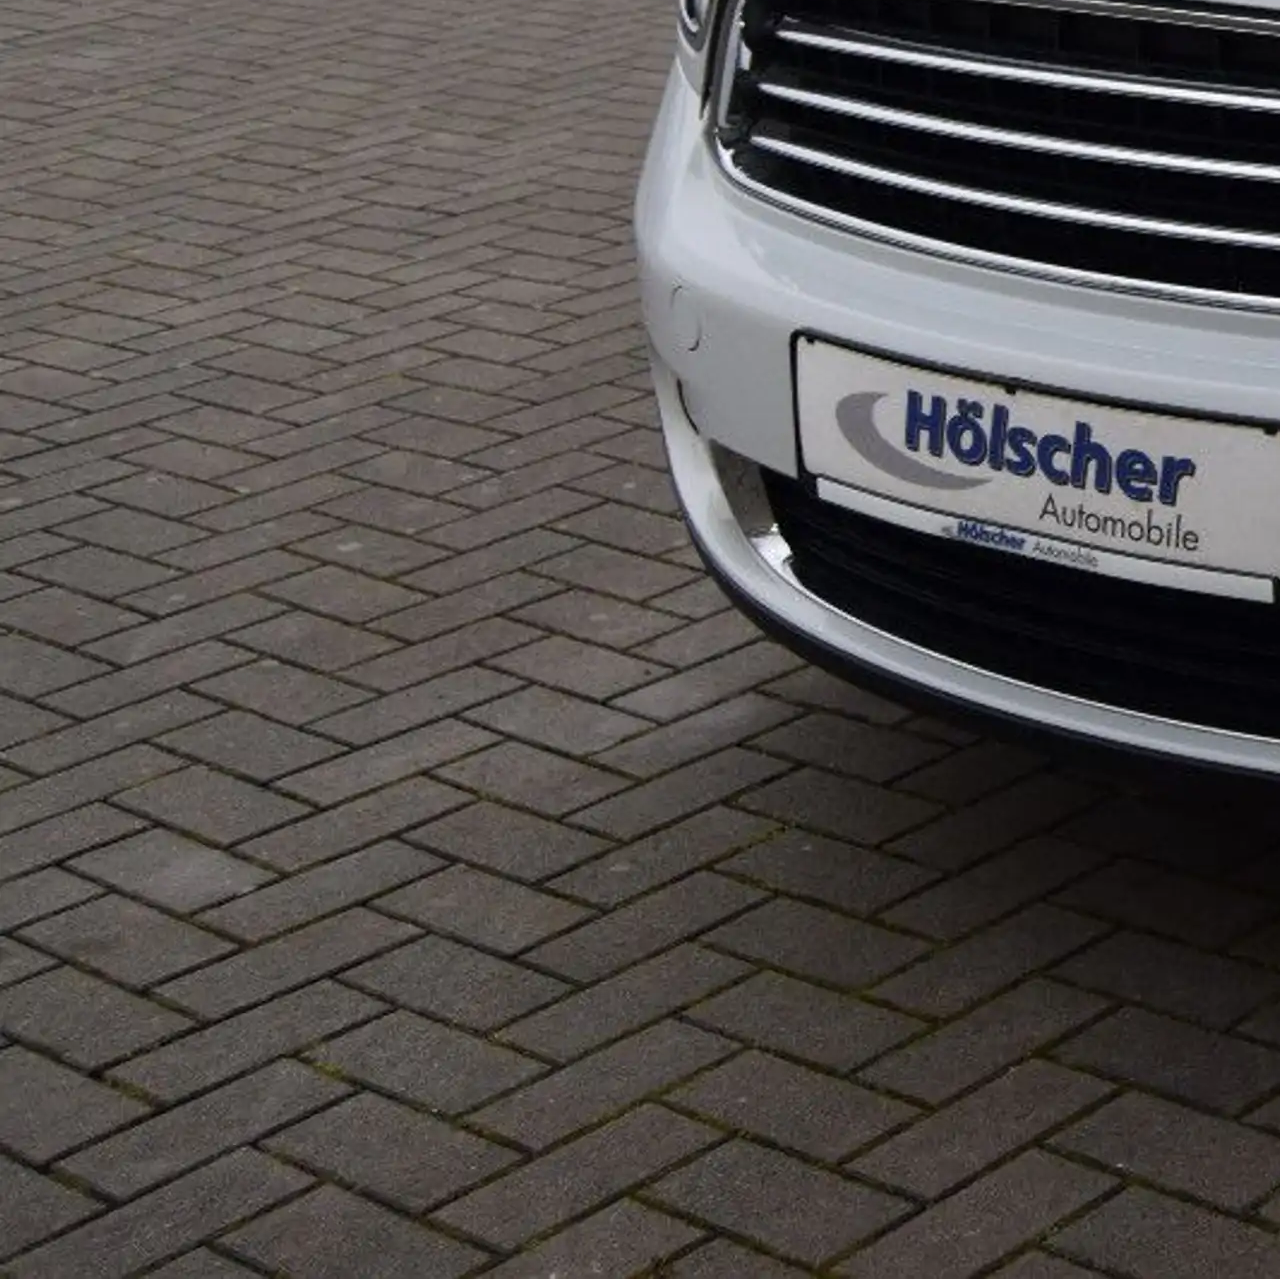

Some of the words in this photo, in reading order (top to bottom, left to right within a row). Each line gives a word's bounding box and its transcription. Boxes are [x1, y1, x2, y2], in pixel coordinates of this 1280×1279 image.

[905, 390, 1196, 506] Hölscher
[957, 521, 1026, 550] Hölscher
[1039, 493, 1199, 551] Automobile
